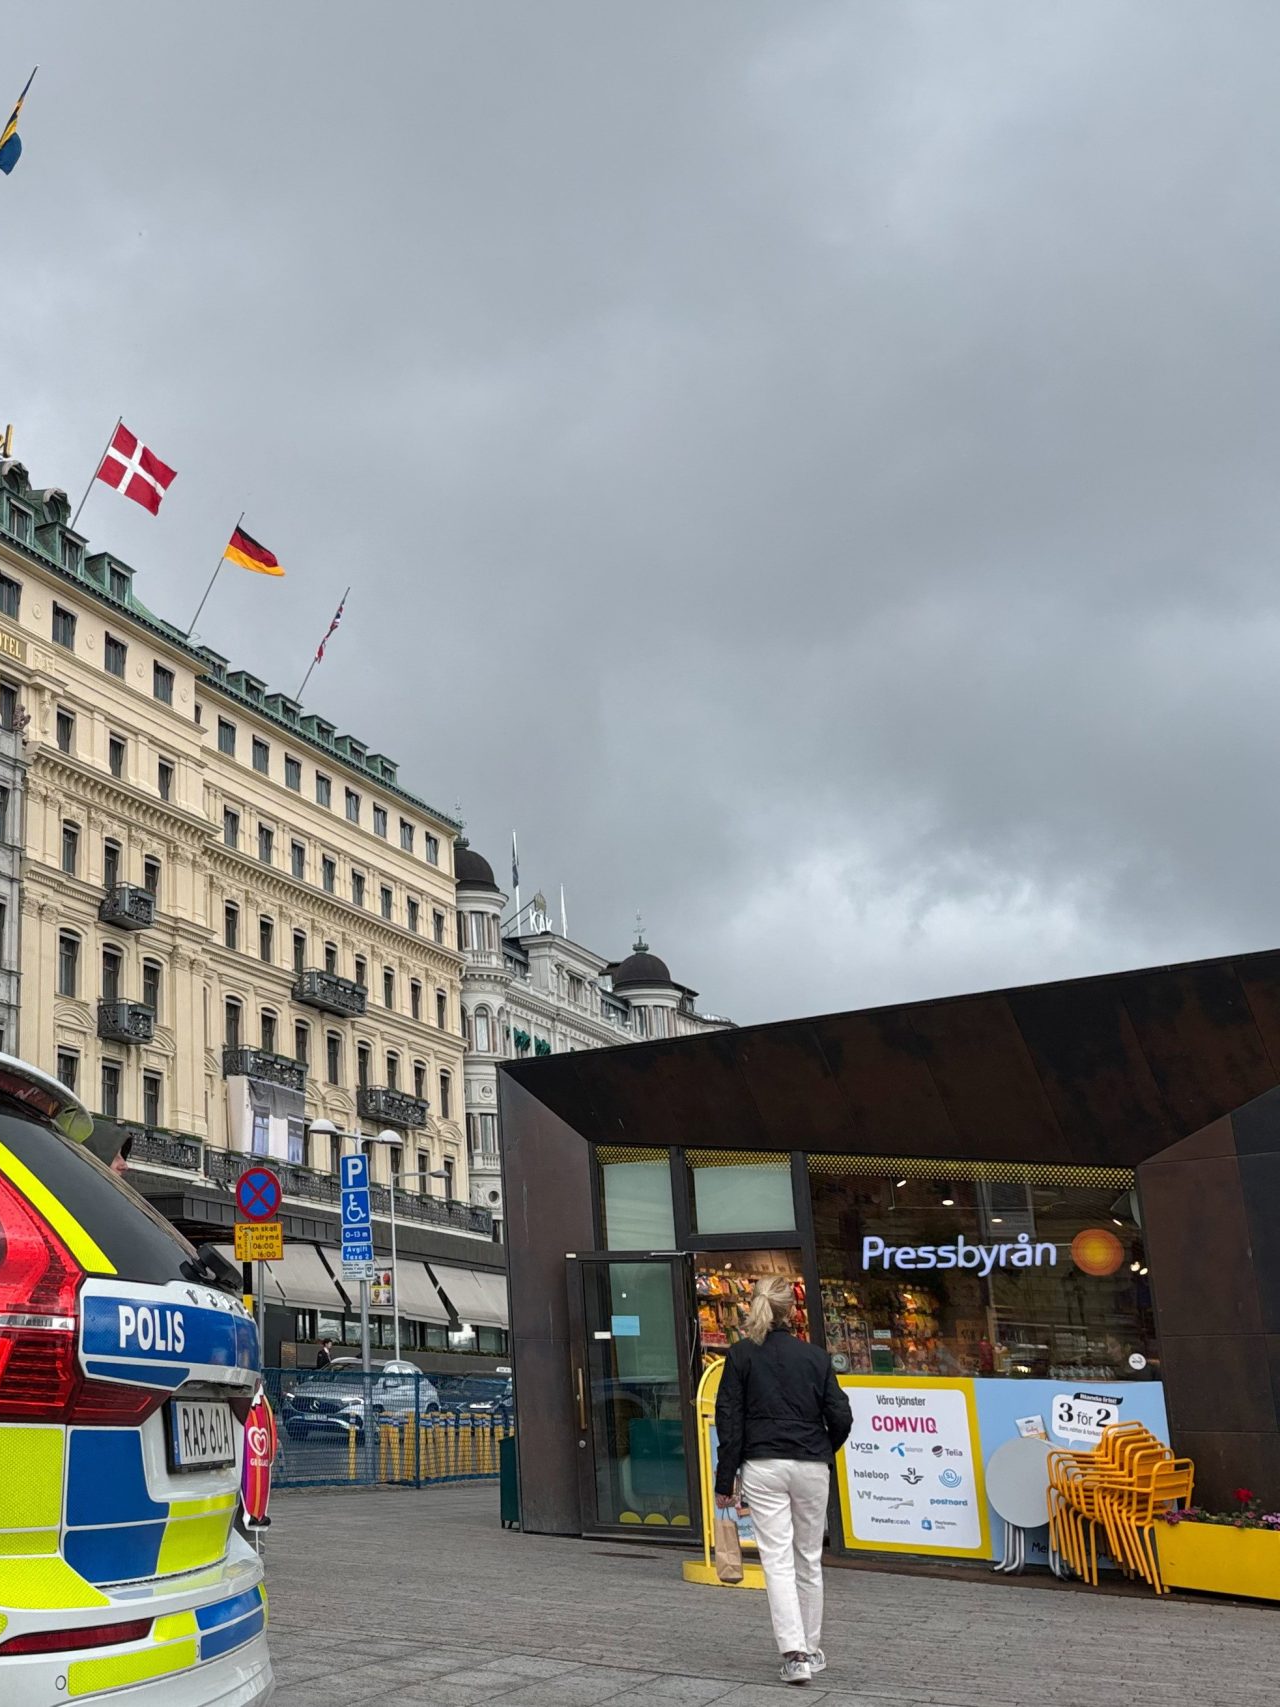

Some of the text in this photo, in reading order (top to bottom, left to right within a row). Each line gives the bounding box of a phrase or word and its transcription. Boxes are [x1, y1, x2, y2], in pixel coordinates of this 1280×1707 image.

[529, 908, 553, 935] KAK
[346, 1158, 363, 1187] P
[347, 1246, 368, 1254] Avgift
[862, 1233, 1057, 1278] Pressbyrån
[118, 1305, 185, 1353] POLIS
[876, 1394, 926, 1408] Våra tjänster
[1058, 1402, 1111, 1428] 3 för 2
[183, 1407, 231, 1457] RAB 60A
[871, 1415, 938, 1434] COMVIQ
[850, 1441, 873, 1452] Lyca
[945, 1448, 963, 1457] Telia
[854, 1469, 890, 1481] halebop
[945, 1472, 955, 1480] SL
[929, 1498, 968, 1506] postnord
